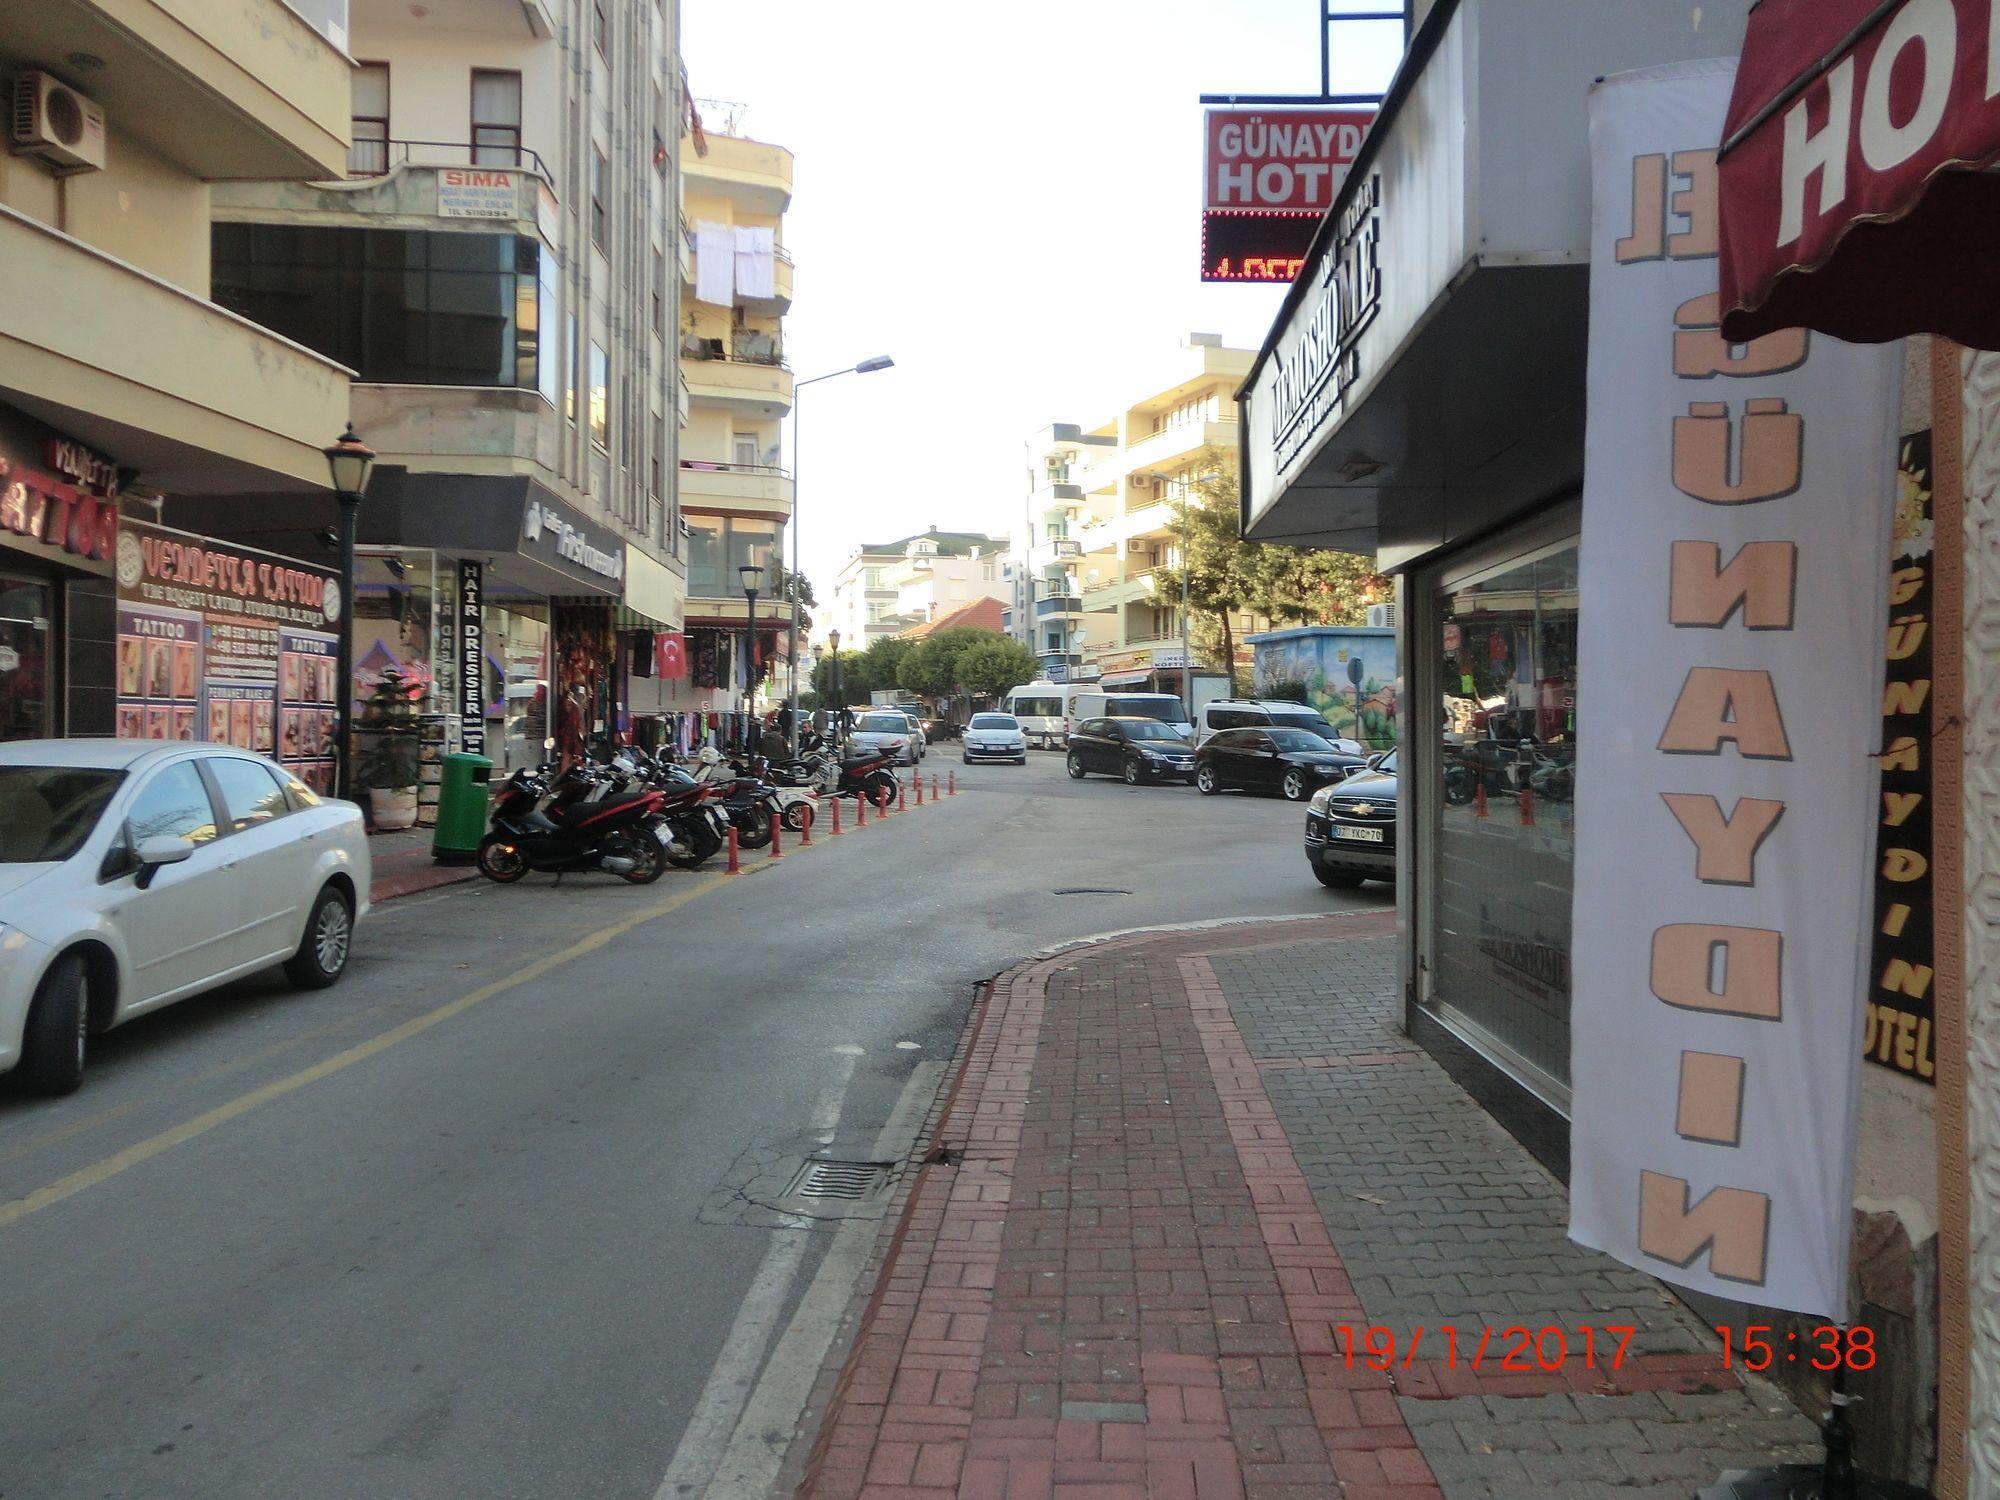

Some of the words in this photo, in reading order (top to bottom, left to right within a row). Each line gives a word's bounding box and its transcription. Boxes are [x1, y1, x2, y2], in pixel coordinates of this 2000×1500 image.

[1777, 0, 2000, 248] HO
[0, 458, 118, 560] ATTOO
[463, 566, 479, 617] HAIR
[133, 618, 185, 639] TATTOO
[291, 638, 327, 655] TATTOO
[464, 625, 481, 714] DRESSER
